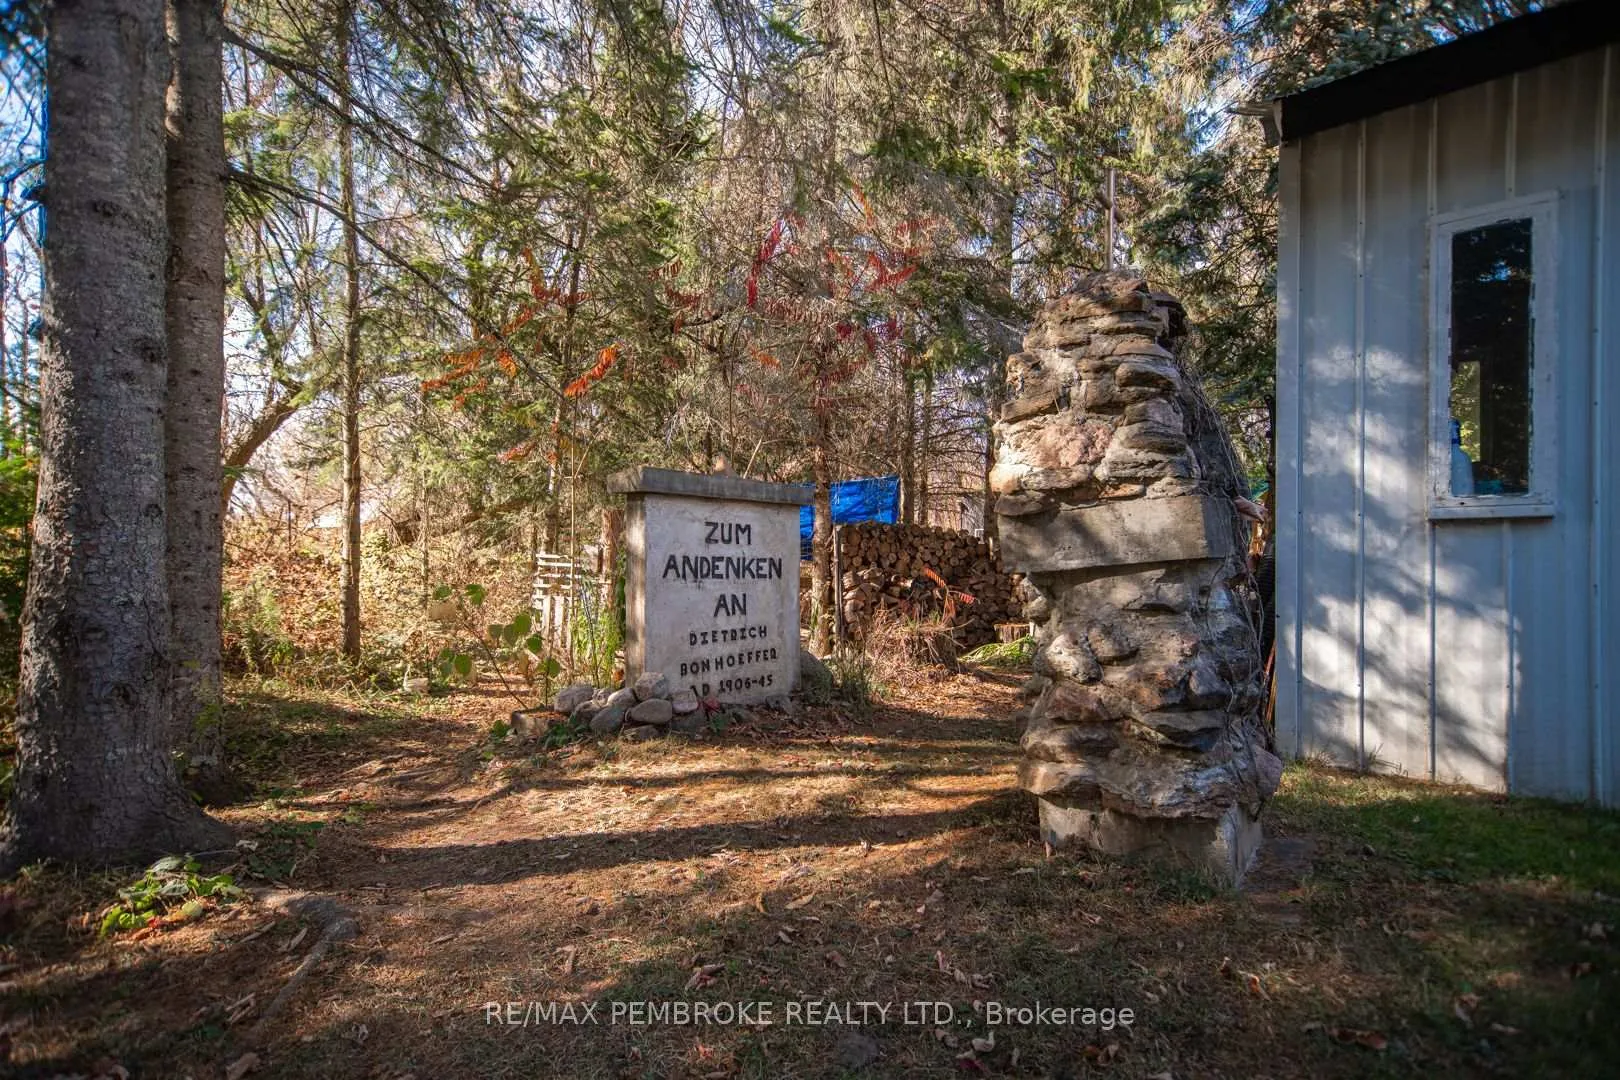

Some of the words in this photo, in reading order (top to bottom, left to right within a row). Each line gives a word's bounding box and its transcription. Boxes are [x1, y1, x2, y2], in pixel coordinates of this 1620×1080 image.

[704, 521, 751, 545] ZUM
[662, 554, 782, 581] ANDENKEN
[713, 593, 747, 617] AN
[689, 625, 767, 646] DIETRICH
[719, 674, 773, 693] 1906-45
